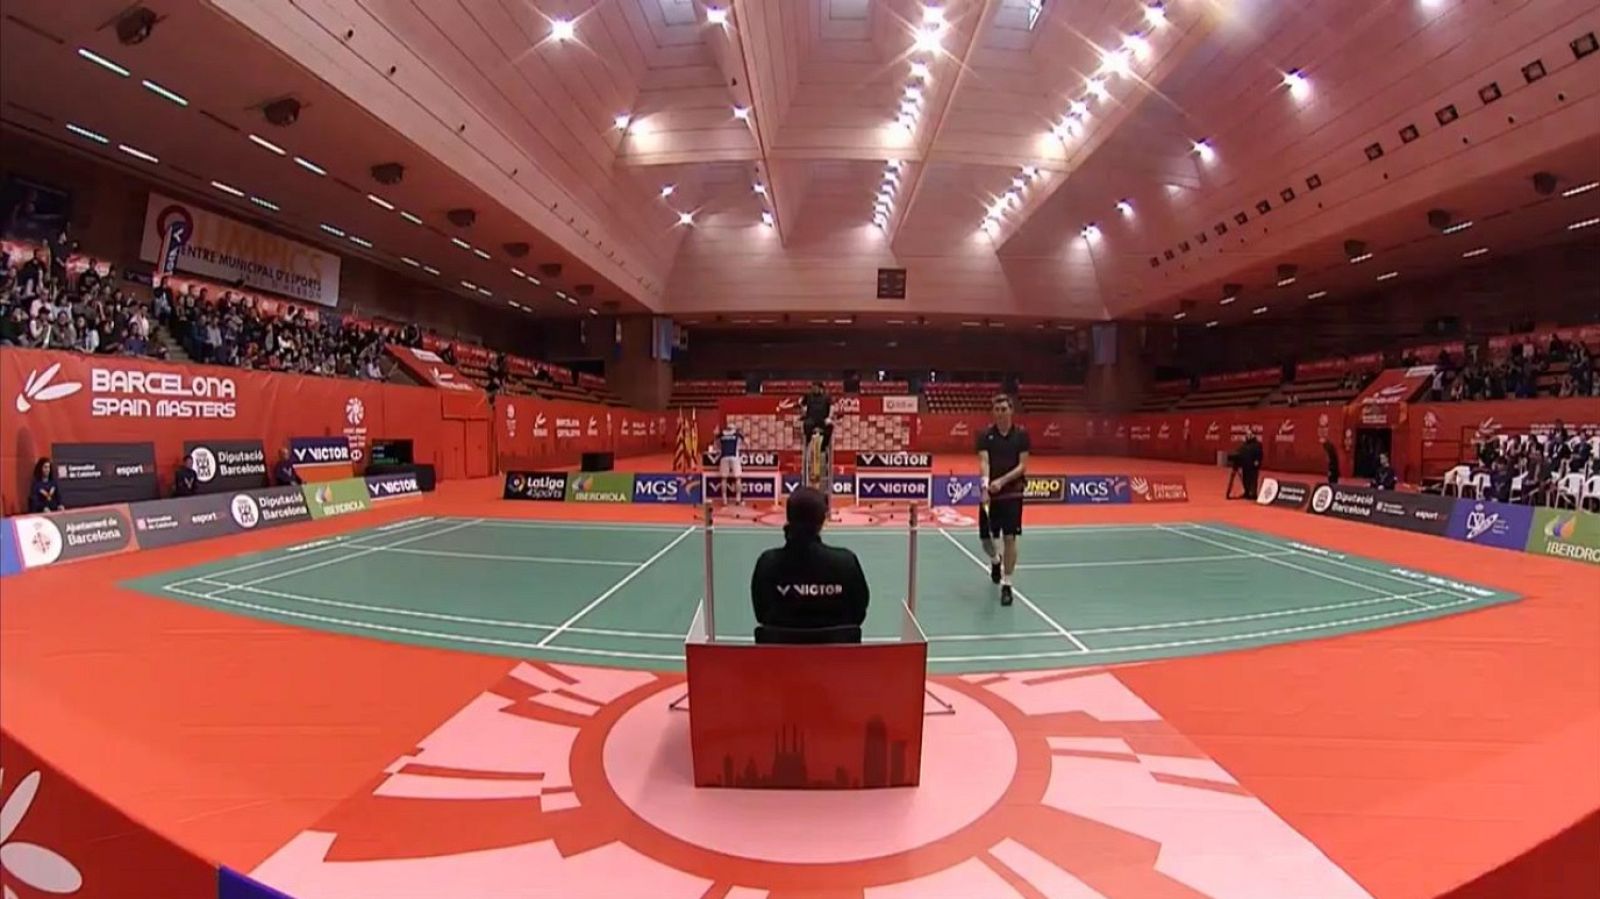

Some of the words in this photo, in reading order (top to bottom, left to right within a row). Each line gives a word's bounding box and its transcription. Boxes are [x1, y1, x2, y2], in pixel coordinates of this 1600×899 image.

[218, 255, 274, 281] MUNICIPAL
[92, 368, 236, 399] BARCELONA
[92, 399, 151, 416] SPAIN
[156, 400, 236, 418] MASTERS
[218, 450, 264, 463] Diputació
[309, 447, 349, 461] VICTOR
[740, 454, 774, 465] CTOR
[878, 453, 928, 466] VICTOR
[220, 463, 265, 476] Barcelona
[383, 479, 418, 494] VICTOR
[527, 475, 565, 490] LaLiga
[635, 481, 678, 495] MGS
[878, 482, 926, 494] VICTOR
[1070, 482, 1108, 496] MGS
[259, 492, 304, 508] Diputació
[575, 492, 627, 502] IBERDROLA
[1335, 491, 1374, 504] Diputació
[262, 505, 308, 520] Barcelona
[1332, 501, 1371, 516] Barcelona
[66, 520, 107, 533] Ajuntament
[68, 530, 121, 546] Barcelona
[793, 584, 843, 596] VICTOR
